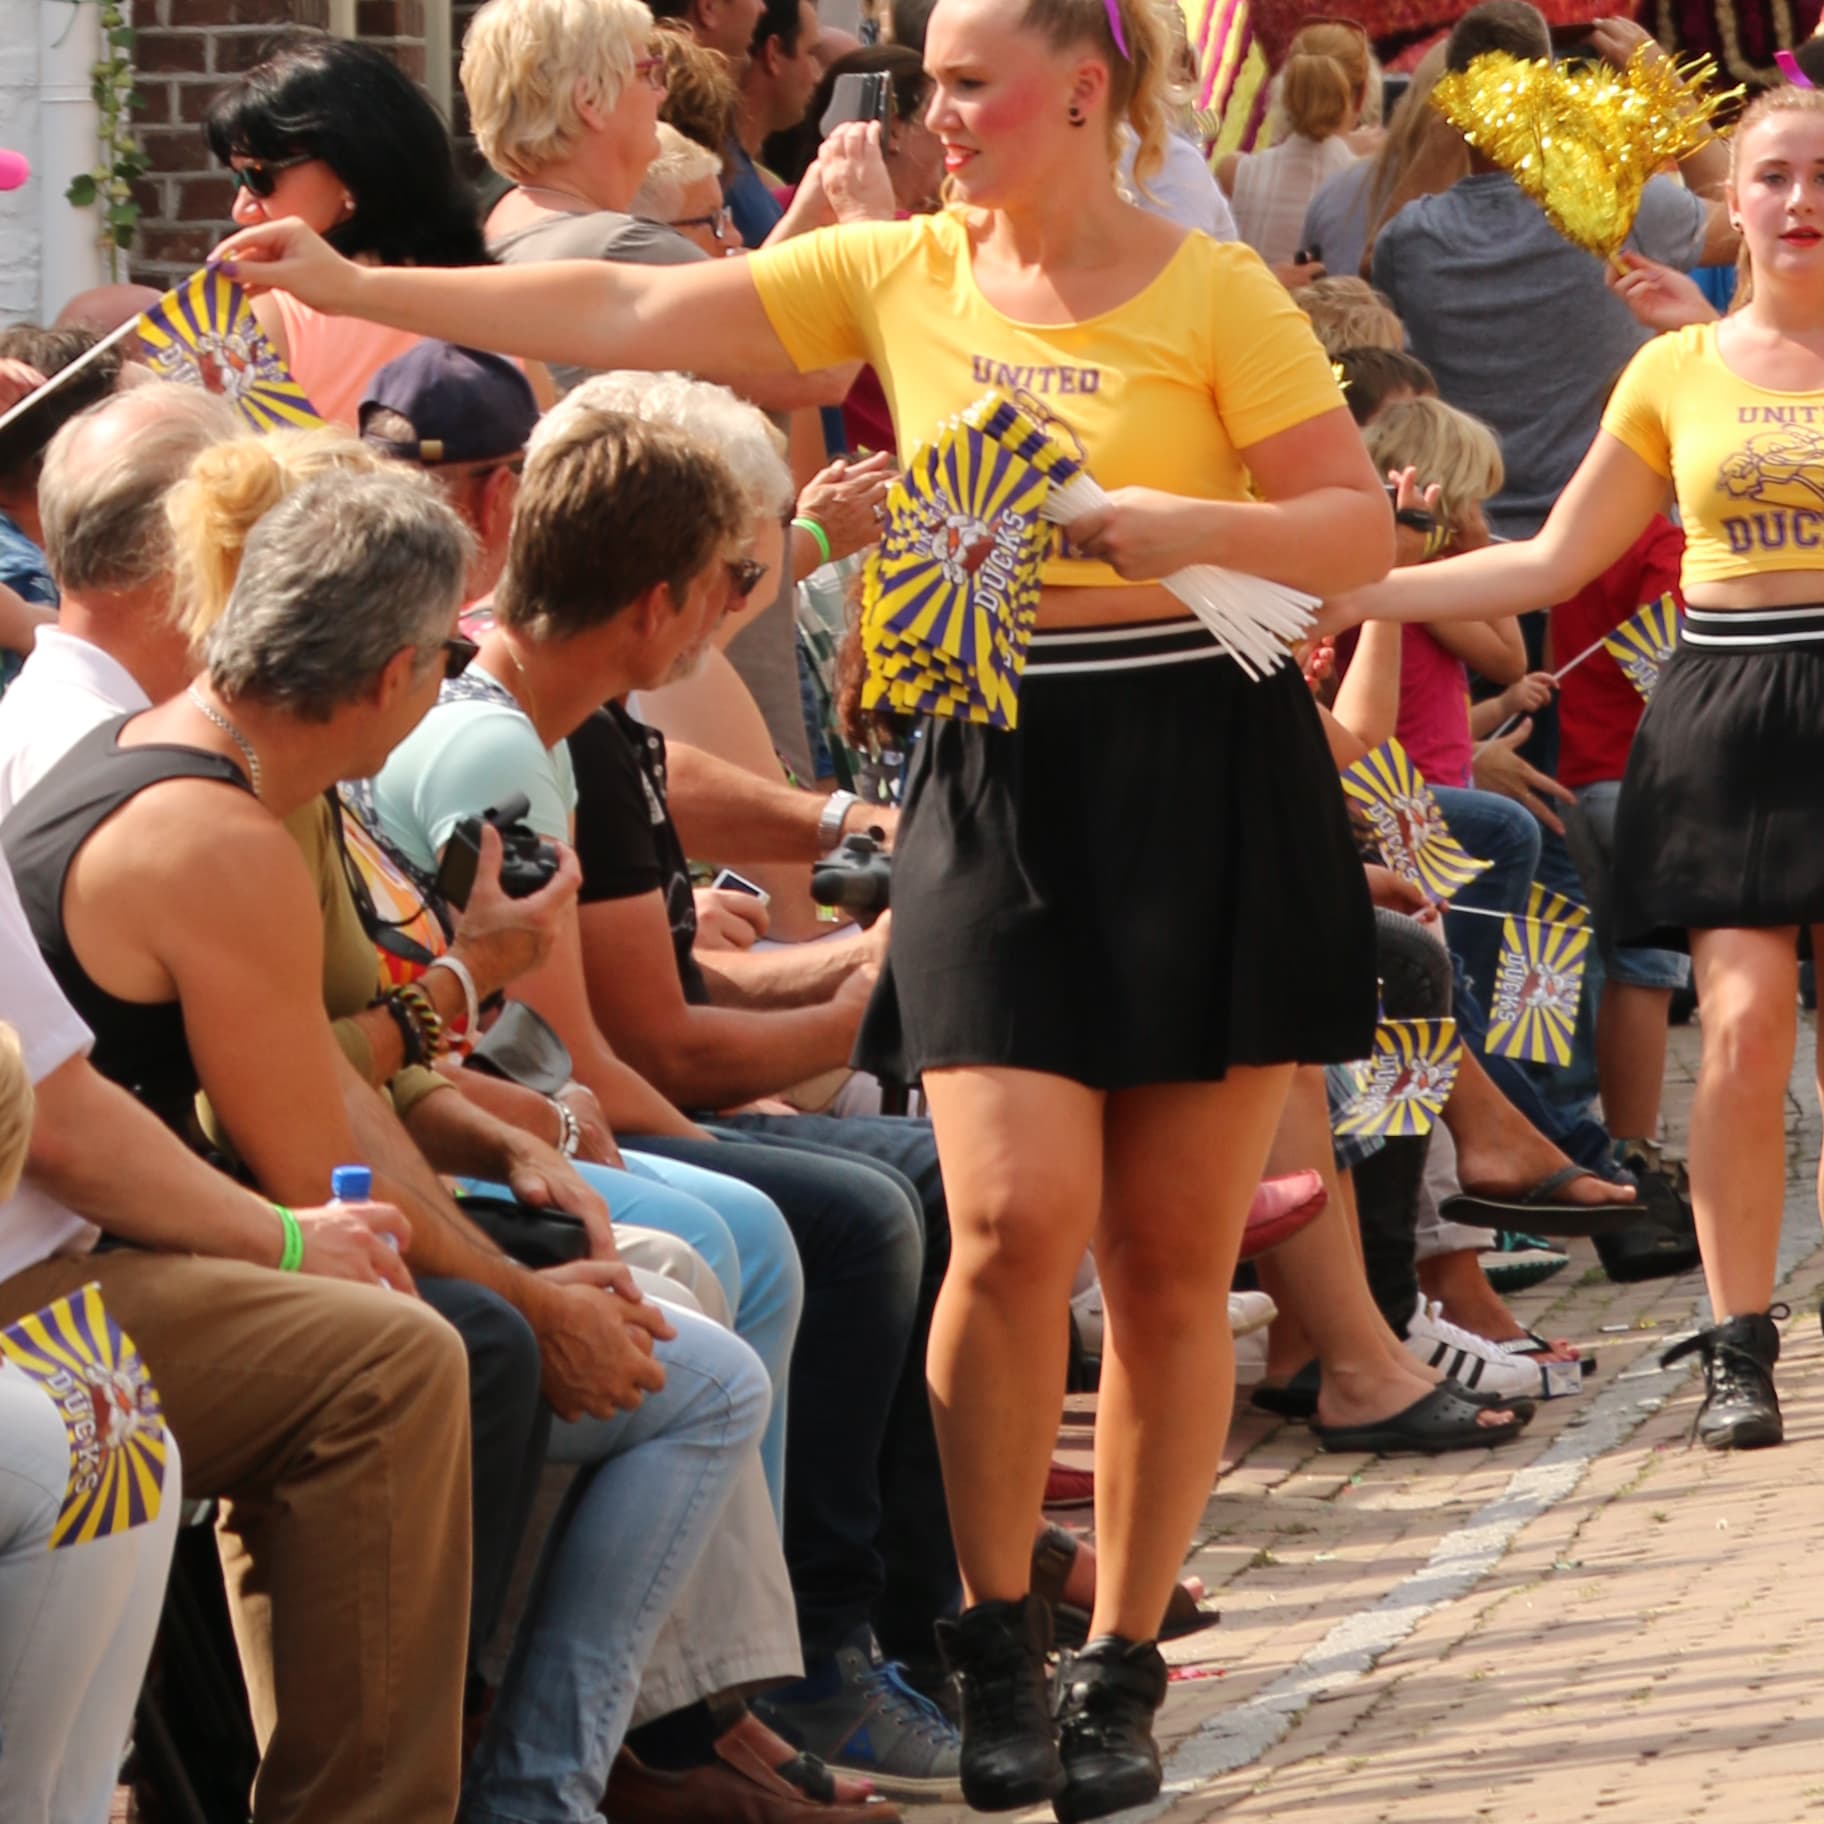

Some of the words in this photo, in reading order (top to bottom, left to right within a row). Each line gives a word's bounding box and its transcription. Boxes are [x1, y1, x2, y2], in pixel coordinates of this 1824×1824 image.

[972, 355, 1100, 394] UNITED
[974, 509, 1026, 614] DUCKS
[47, 1368, 98, 1494] DUCKS
